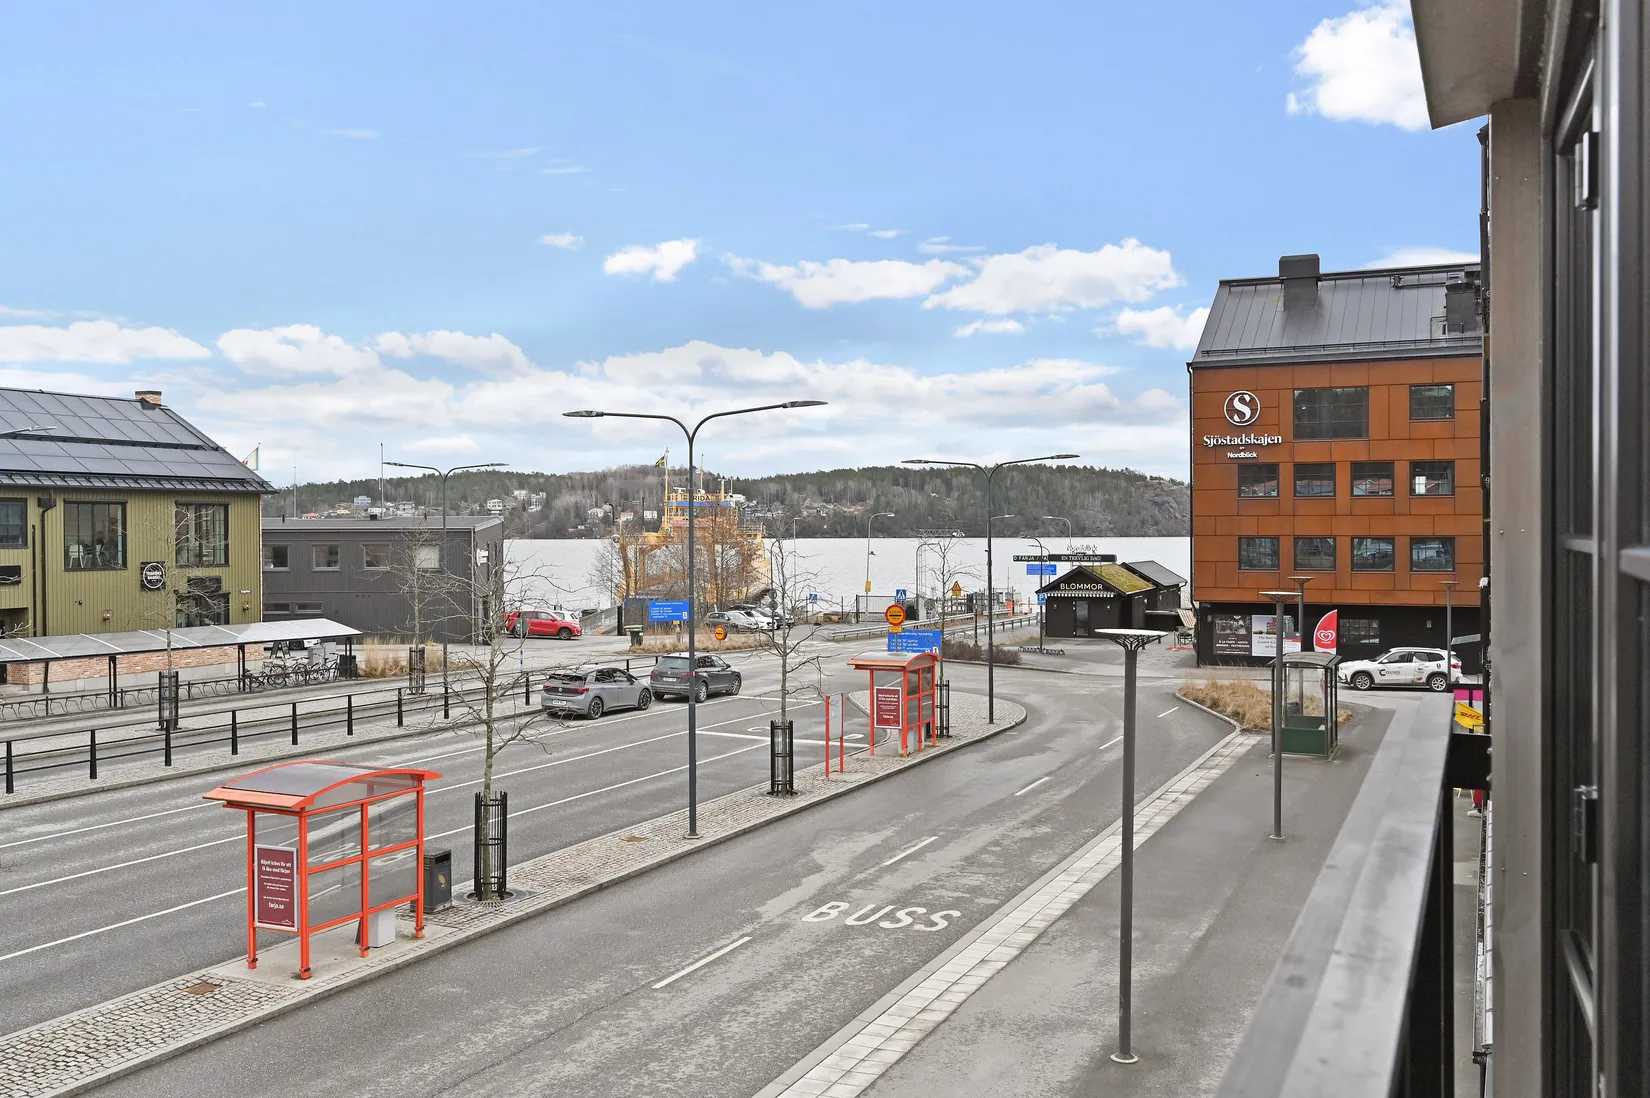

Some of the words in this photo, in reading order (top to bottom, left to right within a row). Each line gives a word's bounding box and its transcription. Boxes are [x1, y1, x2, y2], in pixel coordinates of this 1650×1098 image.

[1203, 433, 1282, 447] Sjöstadskajen
[1460, 711, 1481, 720] DHL
[800, 901, 962, 931] BUSS
